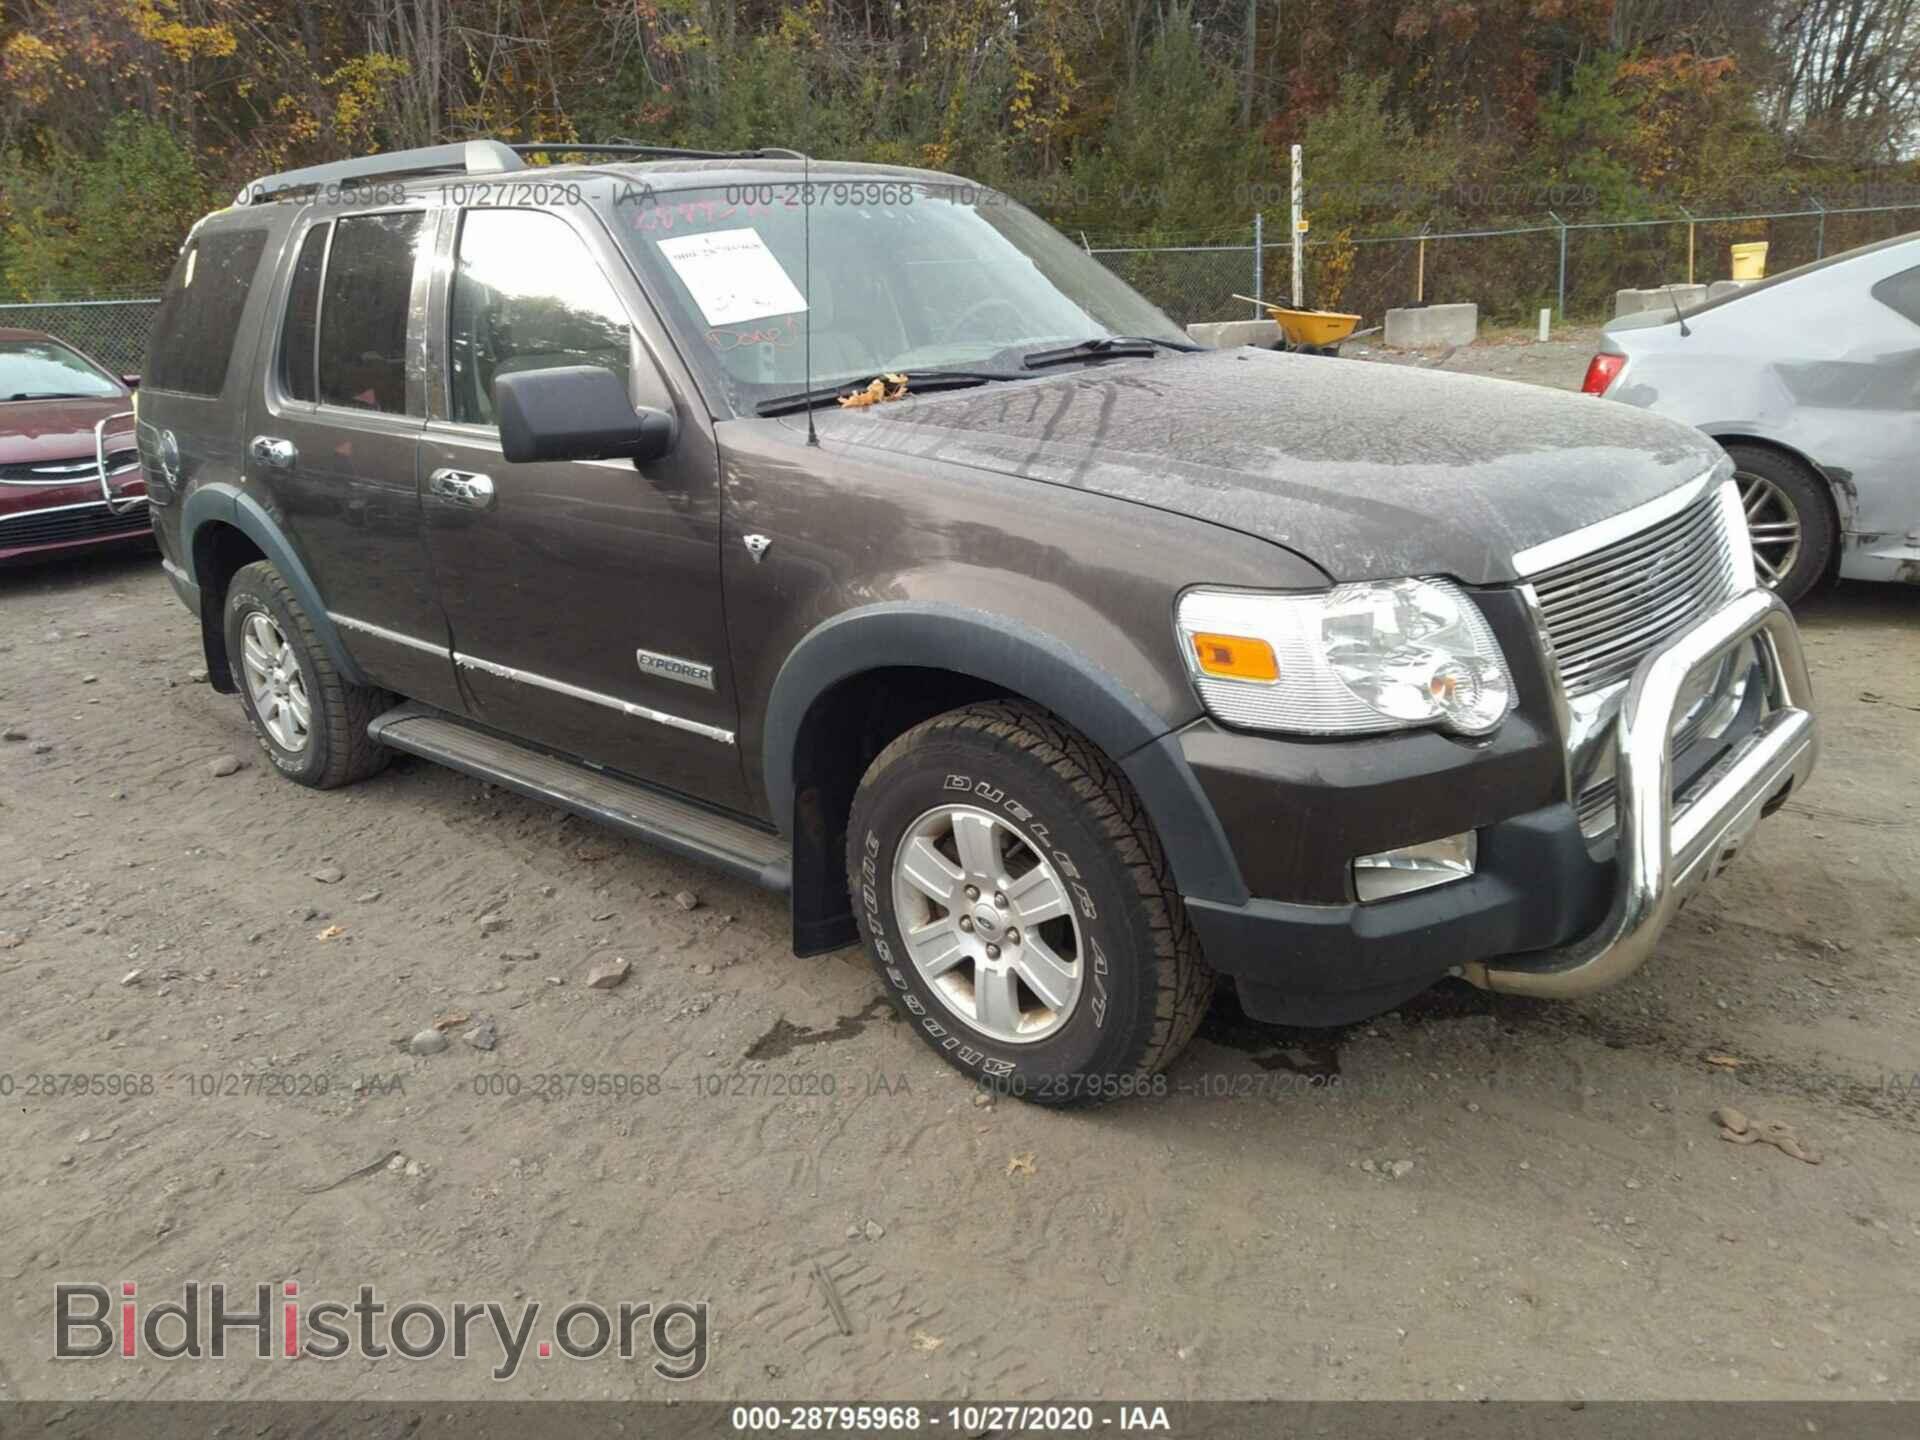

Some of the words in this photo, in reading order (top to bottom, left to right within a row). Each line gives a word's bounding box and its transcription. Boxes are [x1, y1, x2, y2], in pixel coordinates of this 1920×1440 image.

[639, 654, 709, 681] EXPLORER
[944, 775, 1097, 920] DUELER
[863, 829, 1017, 1078] BRIDGESTONE
